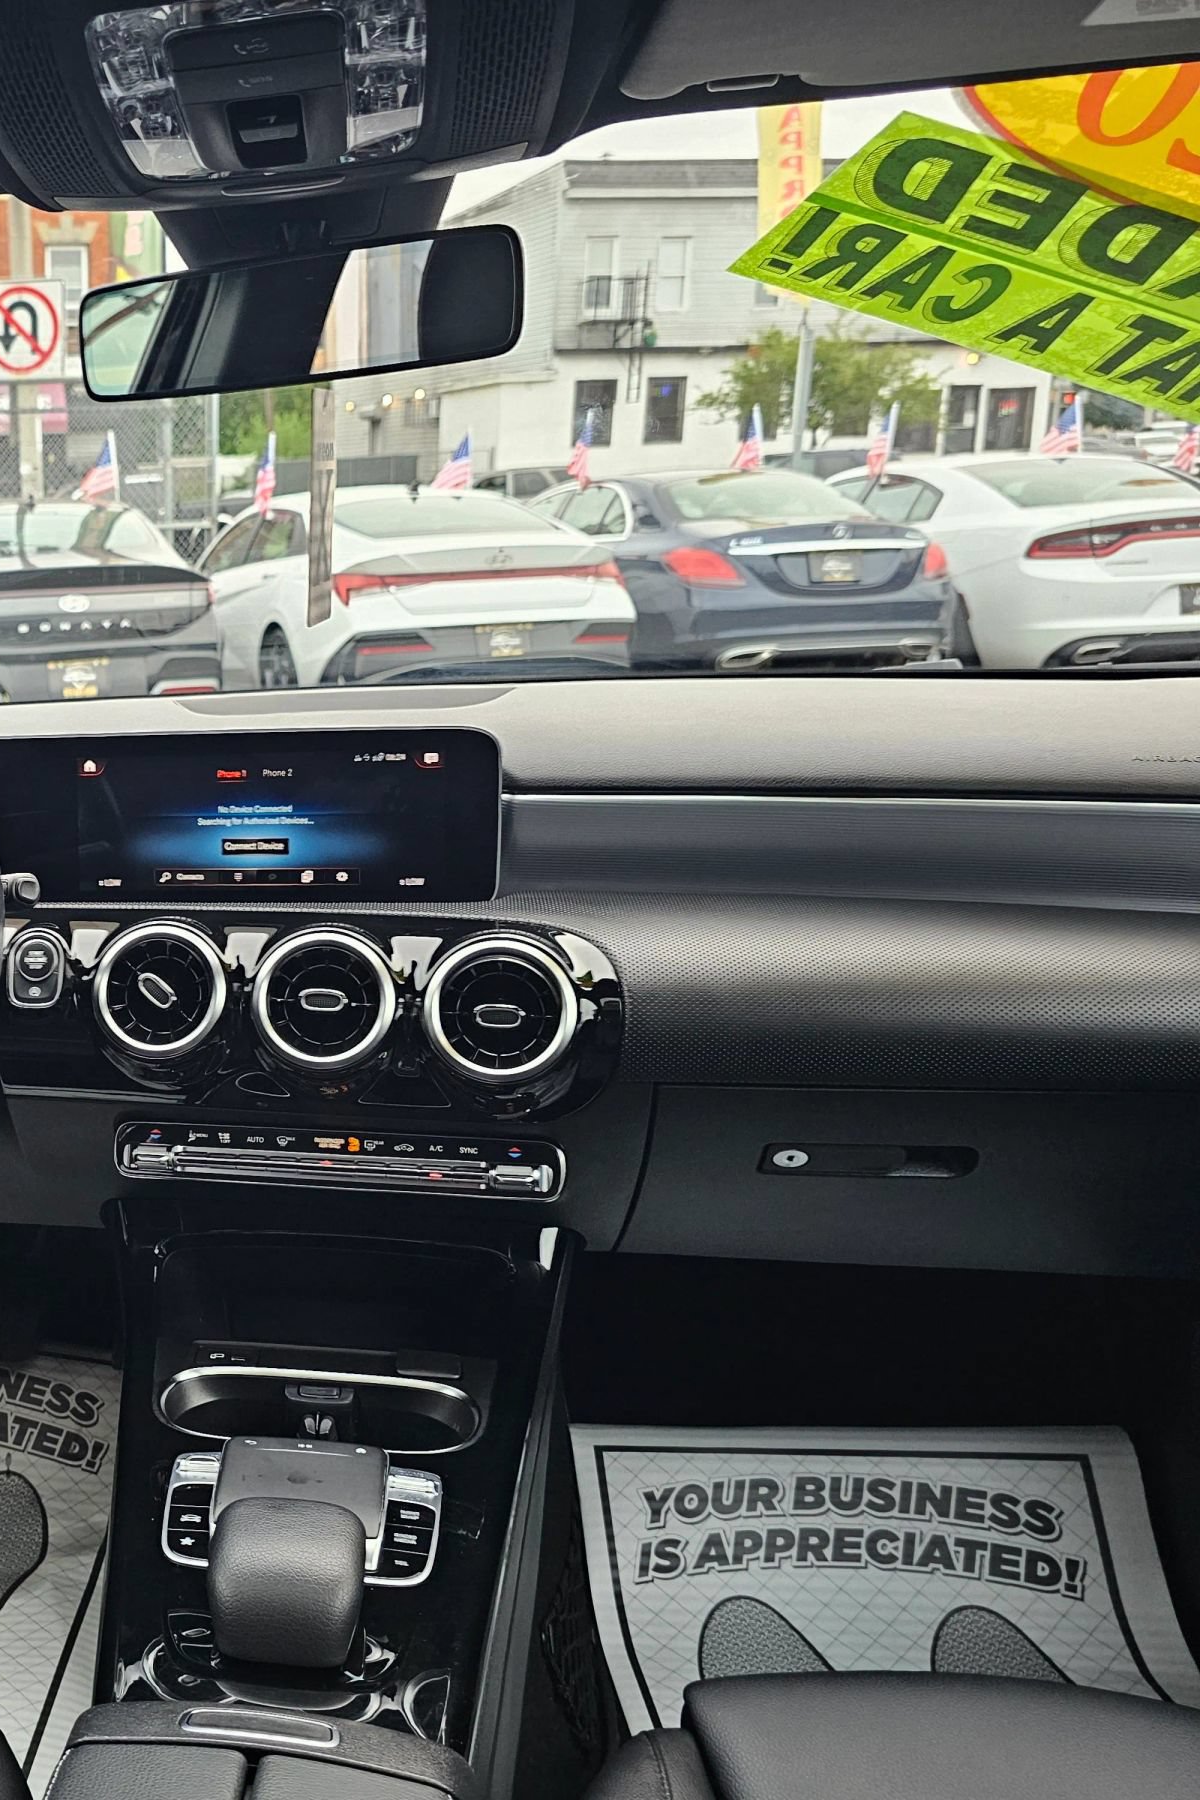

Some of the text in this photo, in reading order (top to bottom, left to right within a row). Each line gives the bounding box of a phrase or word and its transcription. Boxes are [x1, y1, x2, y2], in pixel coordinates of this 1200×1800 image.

[16, 617, 132, 634] SONATA
[262, 768, 293, 778] Phone 2
[224, 841, 285, 851] Connect Device
[246, 1136, 265, 1144] AUTO
[429, 1144, 444, 1152] A/C
[459, 1146, 479, 1154] SYNC
[642, 1476, 1062, 1538] YOUR BUSINESS
[635, 1526, 1085, 1598] IS APPRECIATED!
